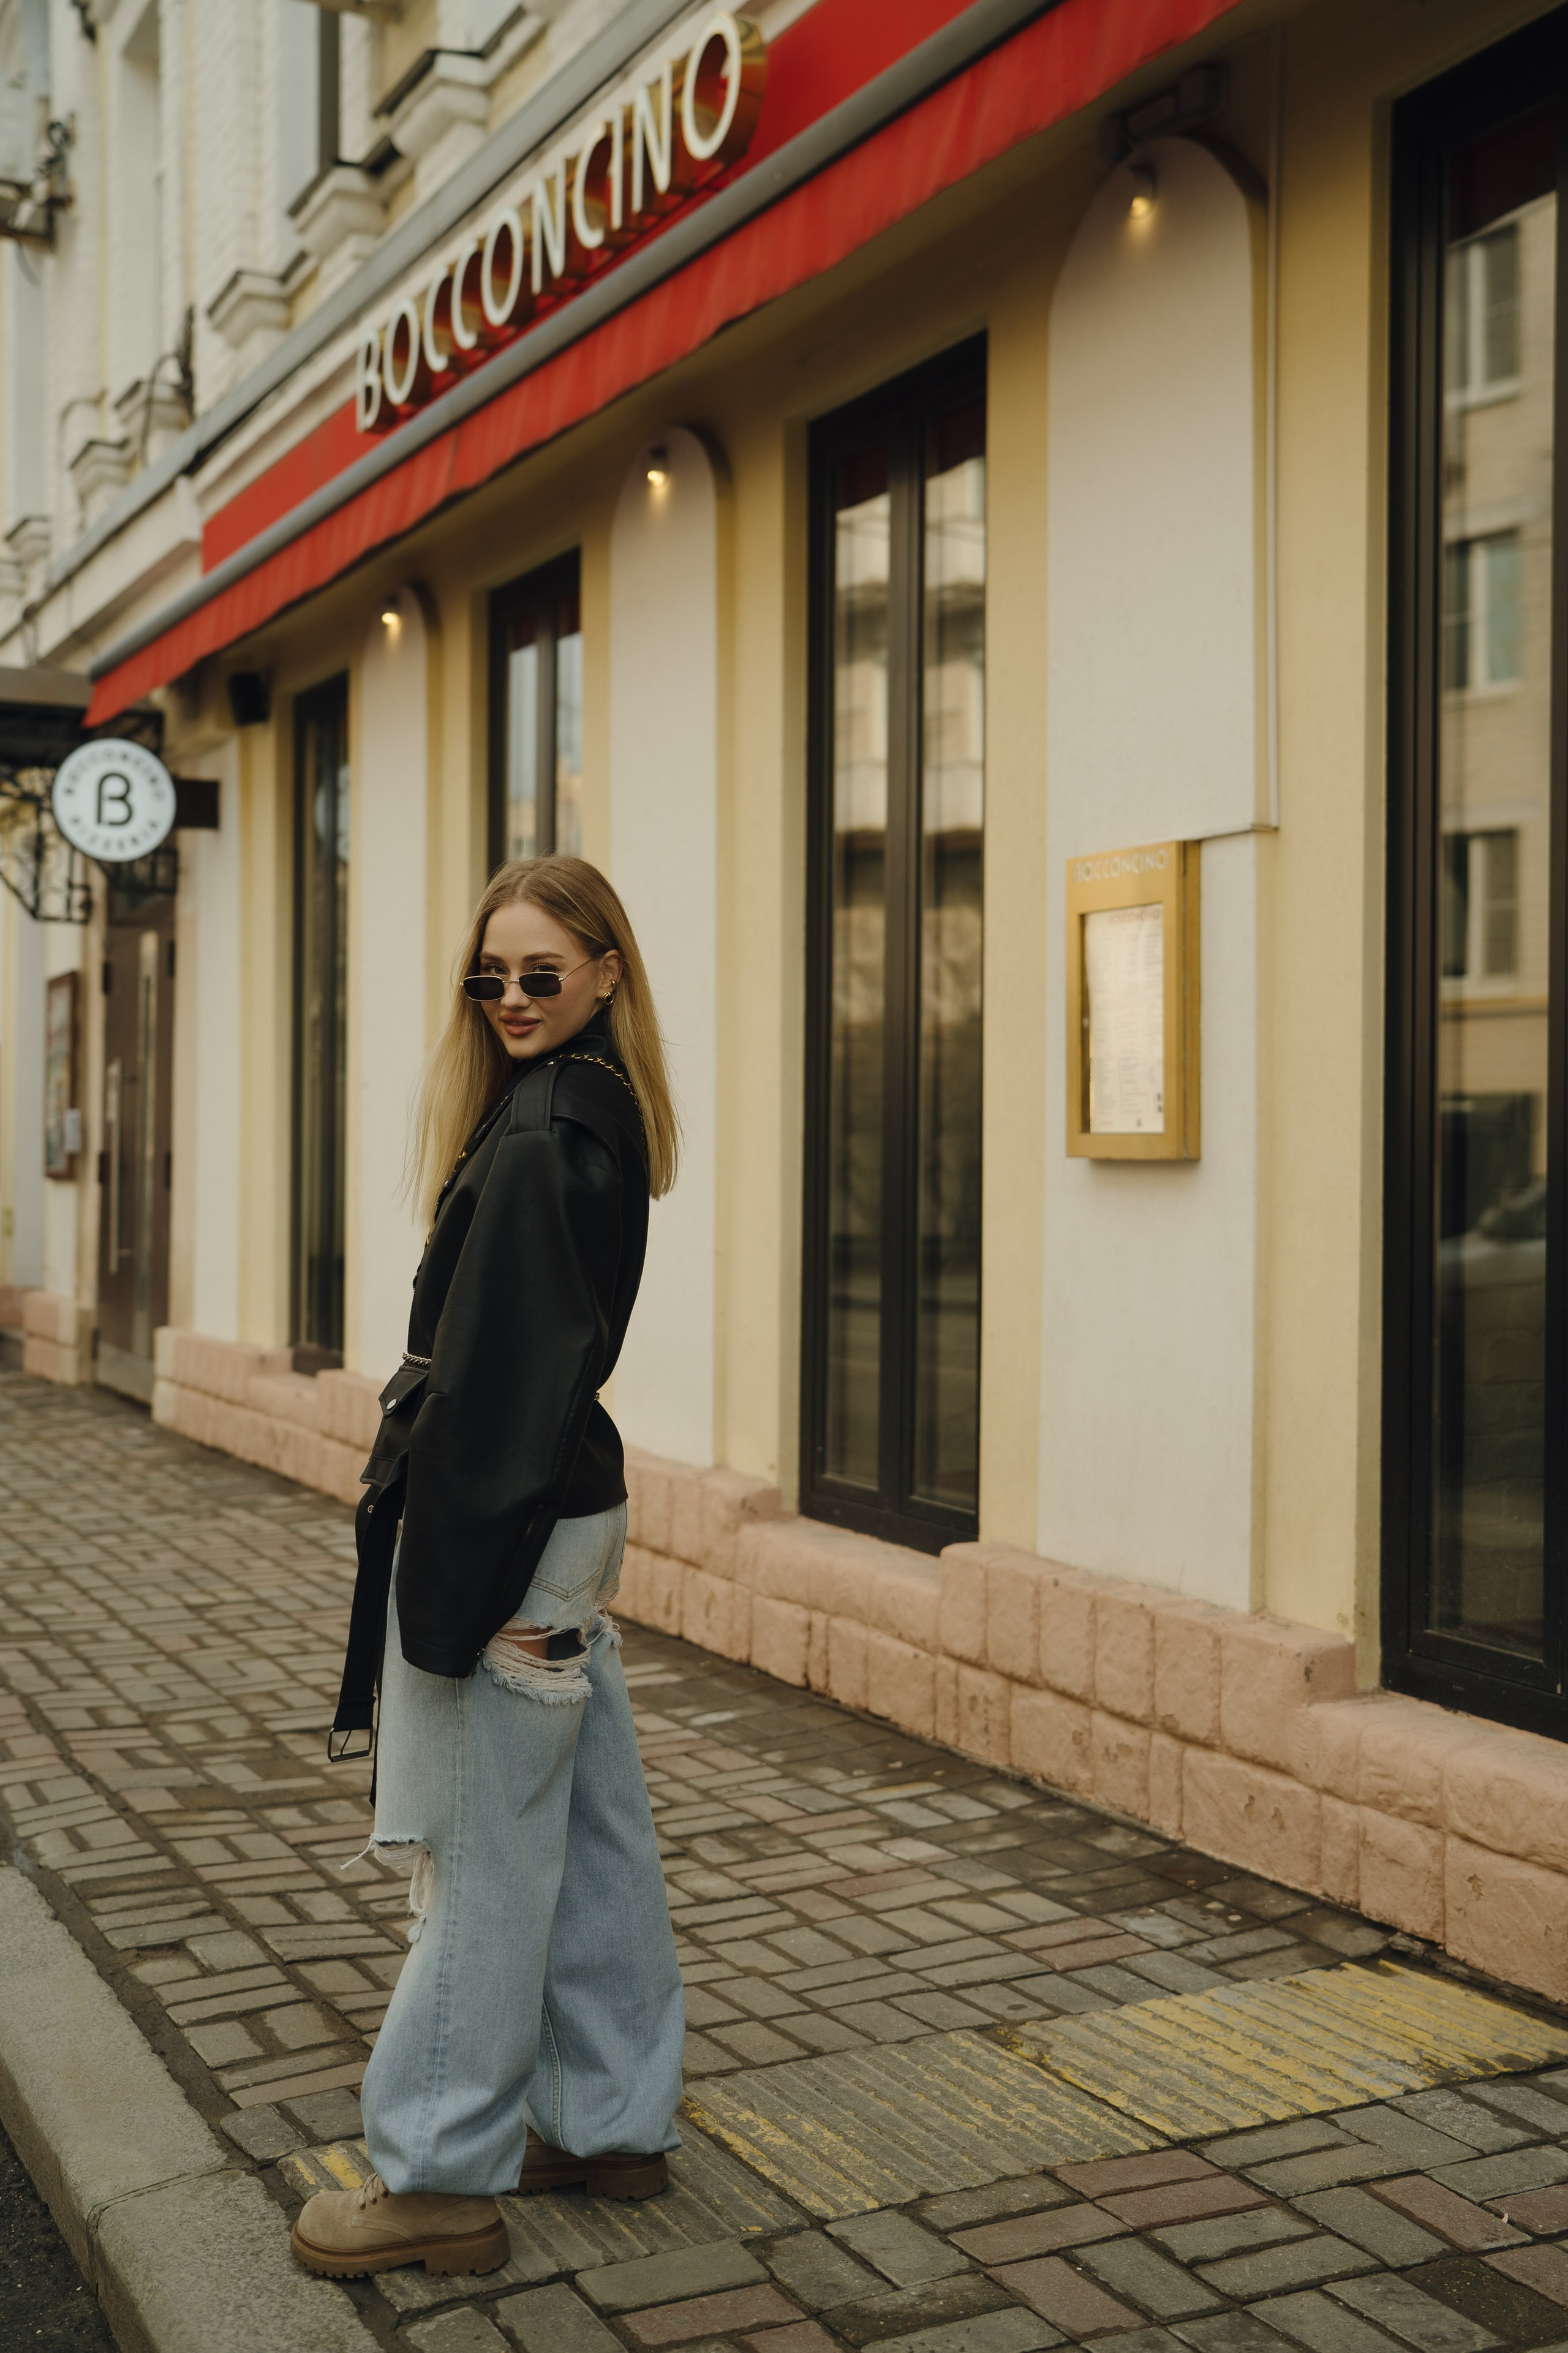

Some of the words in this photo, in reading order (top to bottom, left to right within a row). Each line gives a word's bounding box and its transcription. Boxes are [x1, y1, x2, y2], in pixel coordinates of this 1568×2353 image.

[355, 11, 745, 433] BOCCONCINO
[96, 772, 133, 826] B
[1074, 849, 1168, 882] BOCCONCINO
